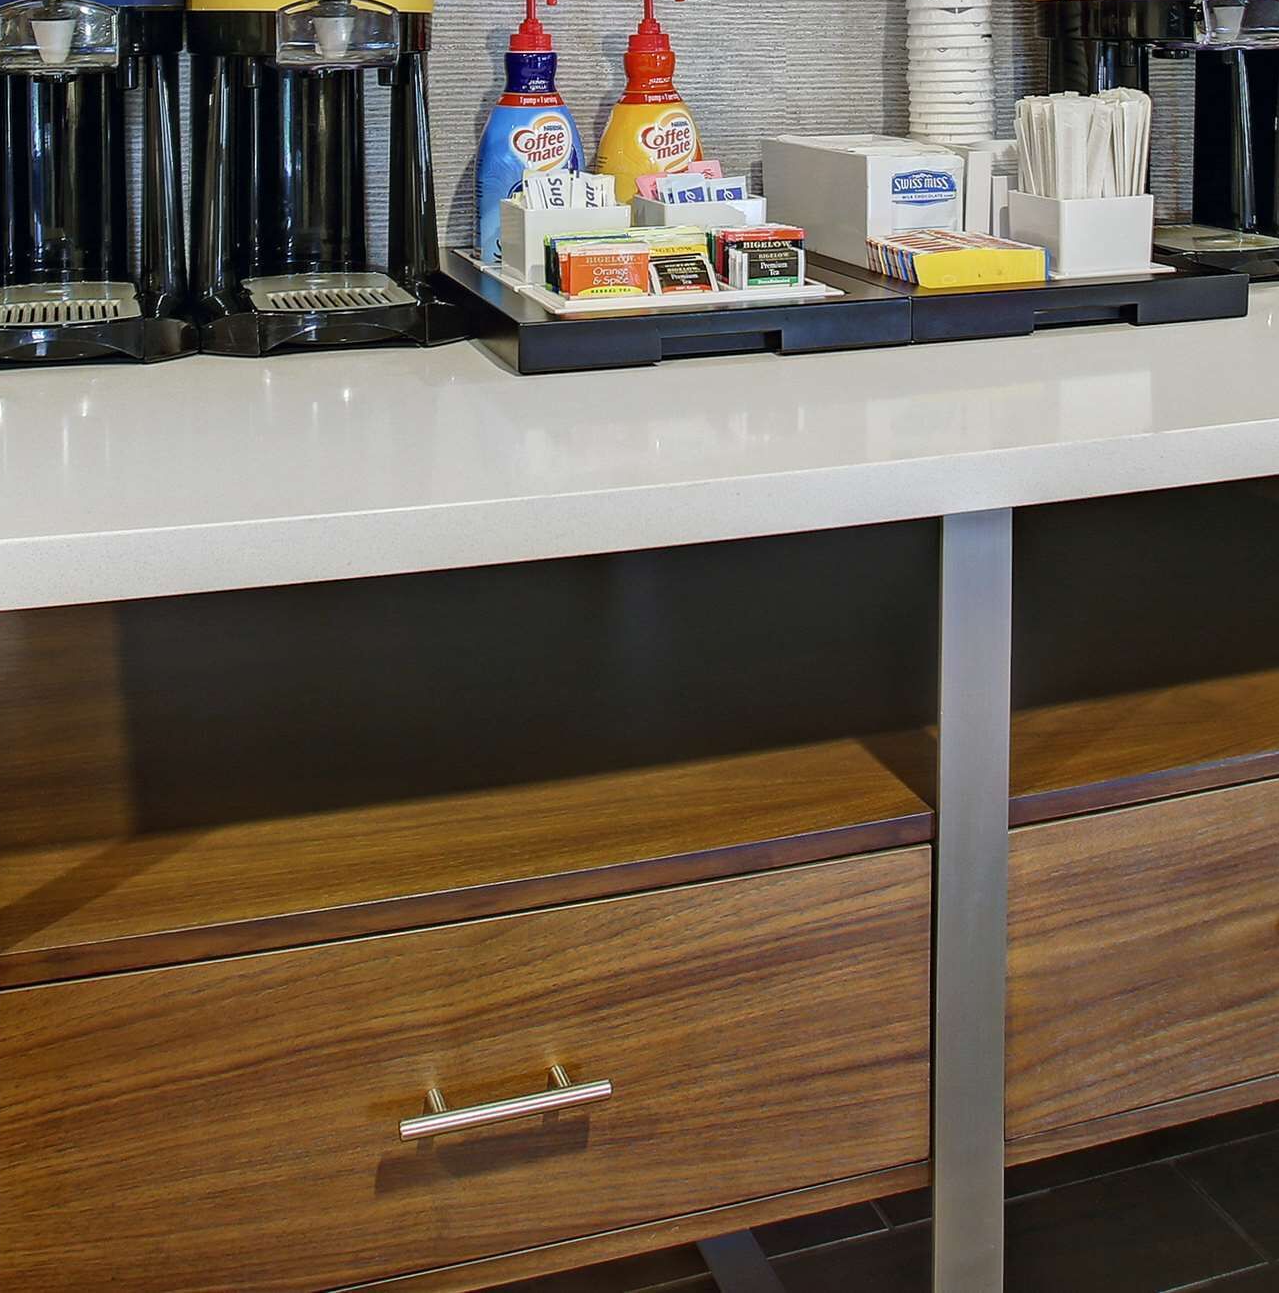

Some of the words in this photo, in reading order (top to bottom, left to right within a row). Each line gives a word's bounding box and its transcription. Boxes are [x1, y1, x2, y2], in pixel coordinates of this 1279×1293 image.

[513, 130, 564, 153] Coffee
[641, 127, 690, 150] Coffee
[527, 145, 564, 162] mate
[657, 141, 690, 159] mate
[743, 241, 792, 249] BIGELOW
[593, 266, 628, 276] Orange
[593, 277, 601, 285] &
[604, 275, 629, 286] Spice
